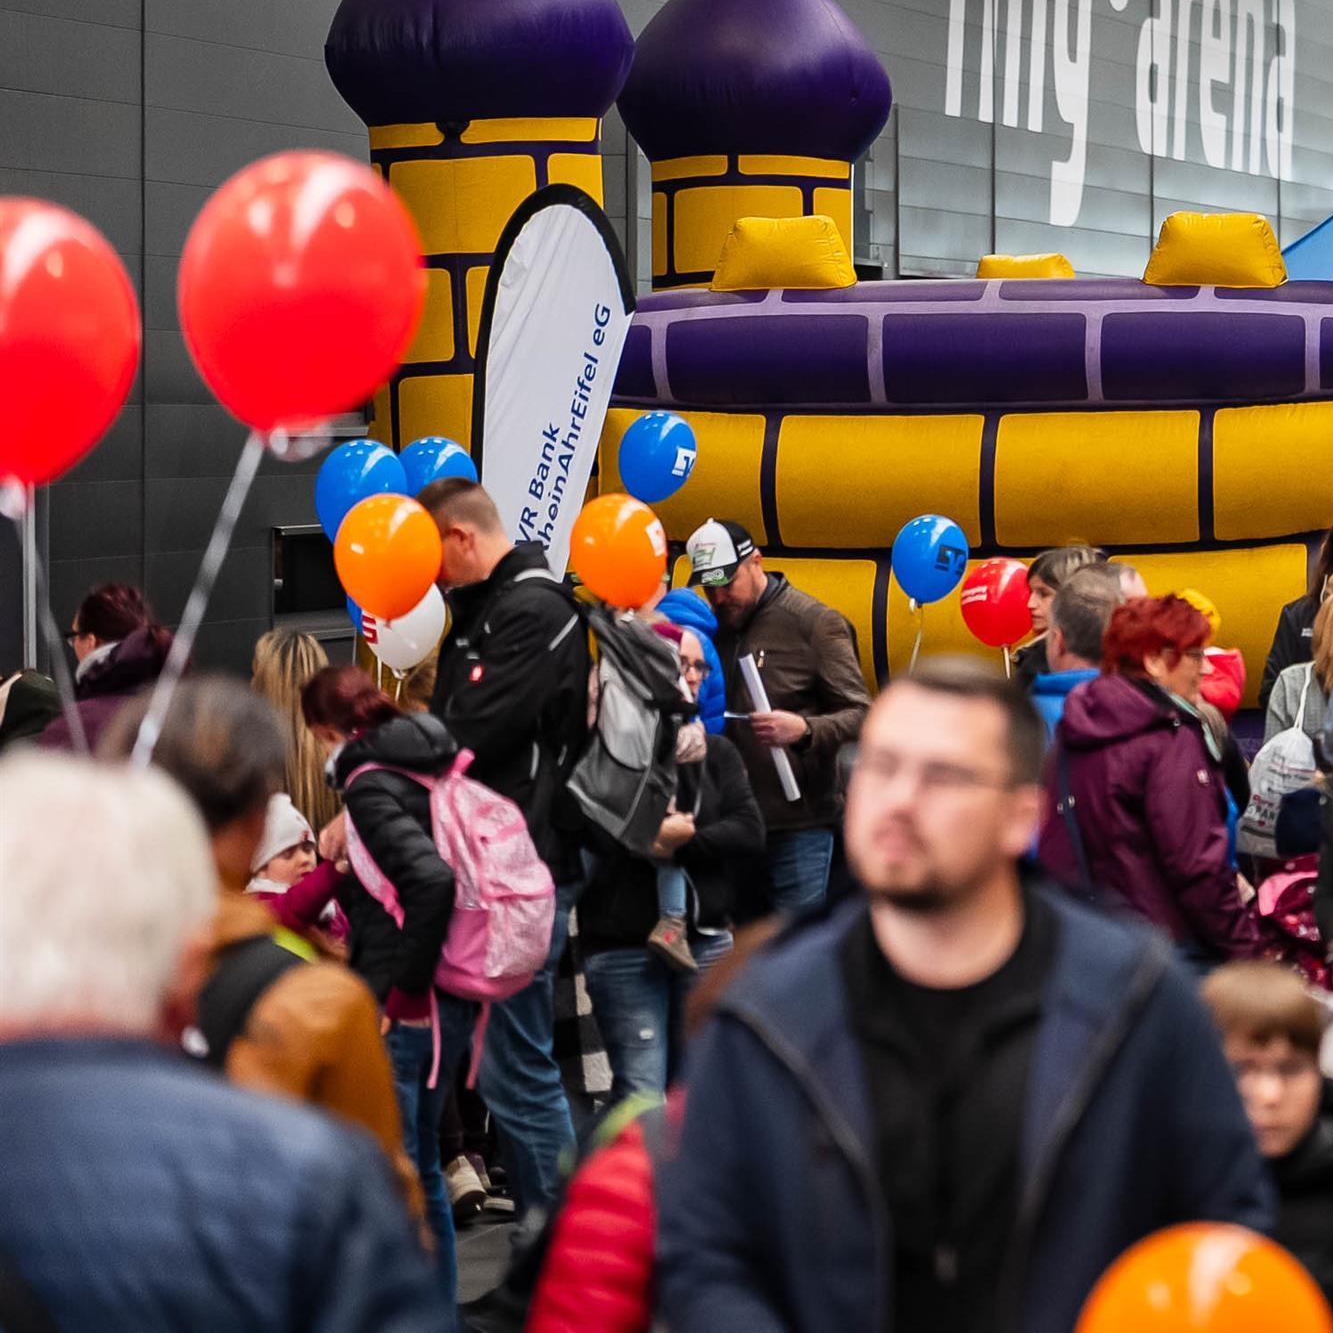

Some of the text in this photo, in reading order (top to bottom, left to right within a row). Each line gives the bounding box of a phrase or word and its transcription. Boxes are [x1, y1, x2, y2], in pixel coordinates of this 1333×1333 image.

[528, 422, 560, 501] Bank
[537, 302, 611, 551] heinAhrEifel eG
